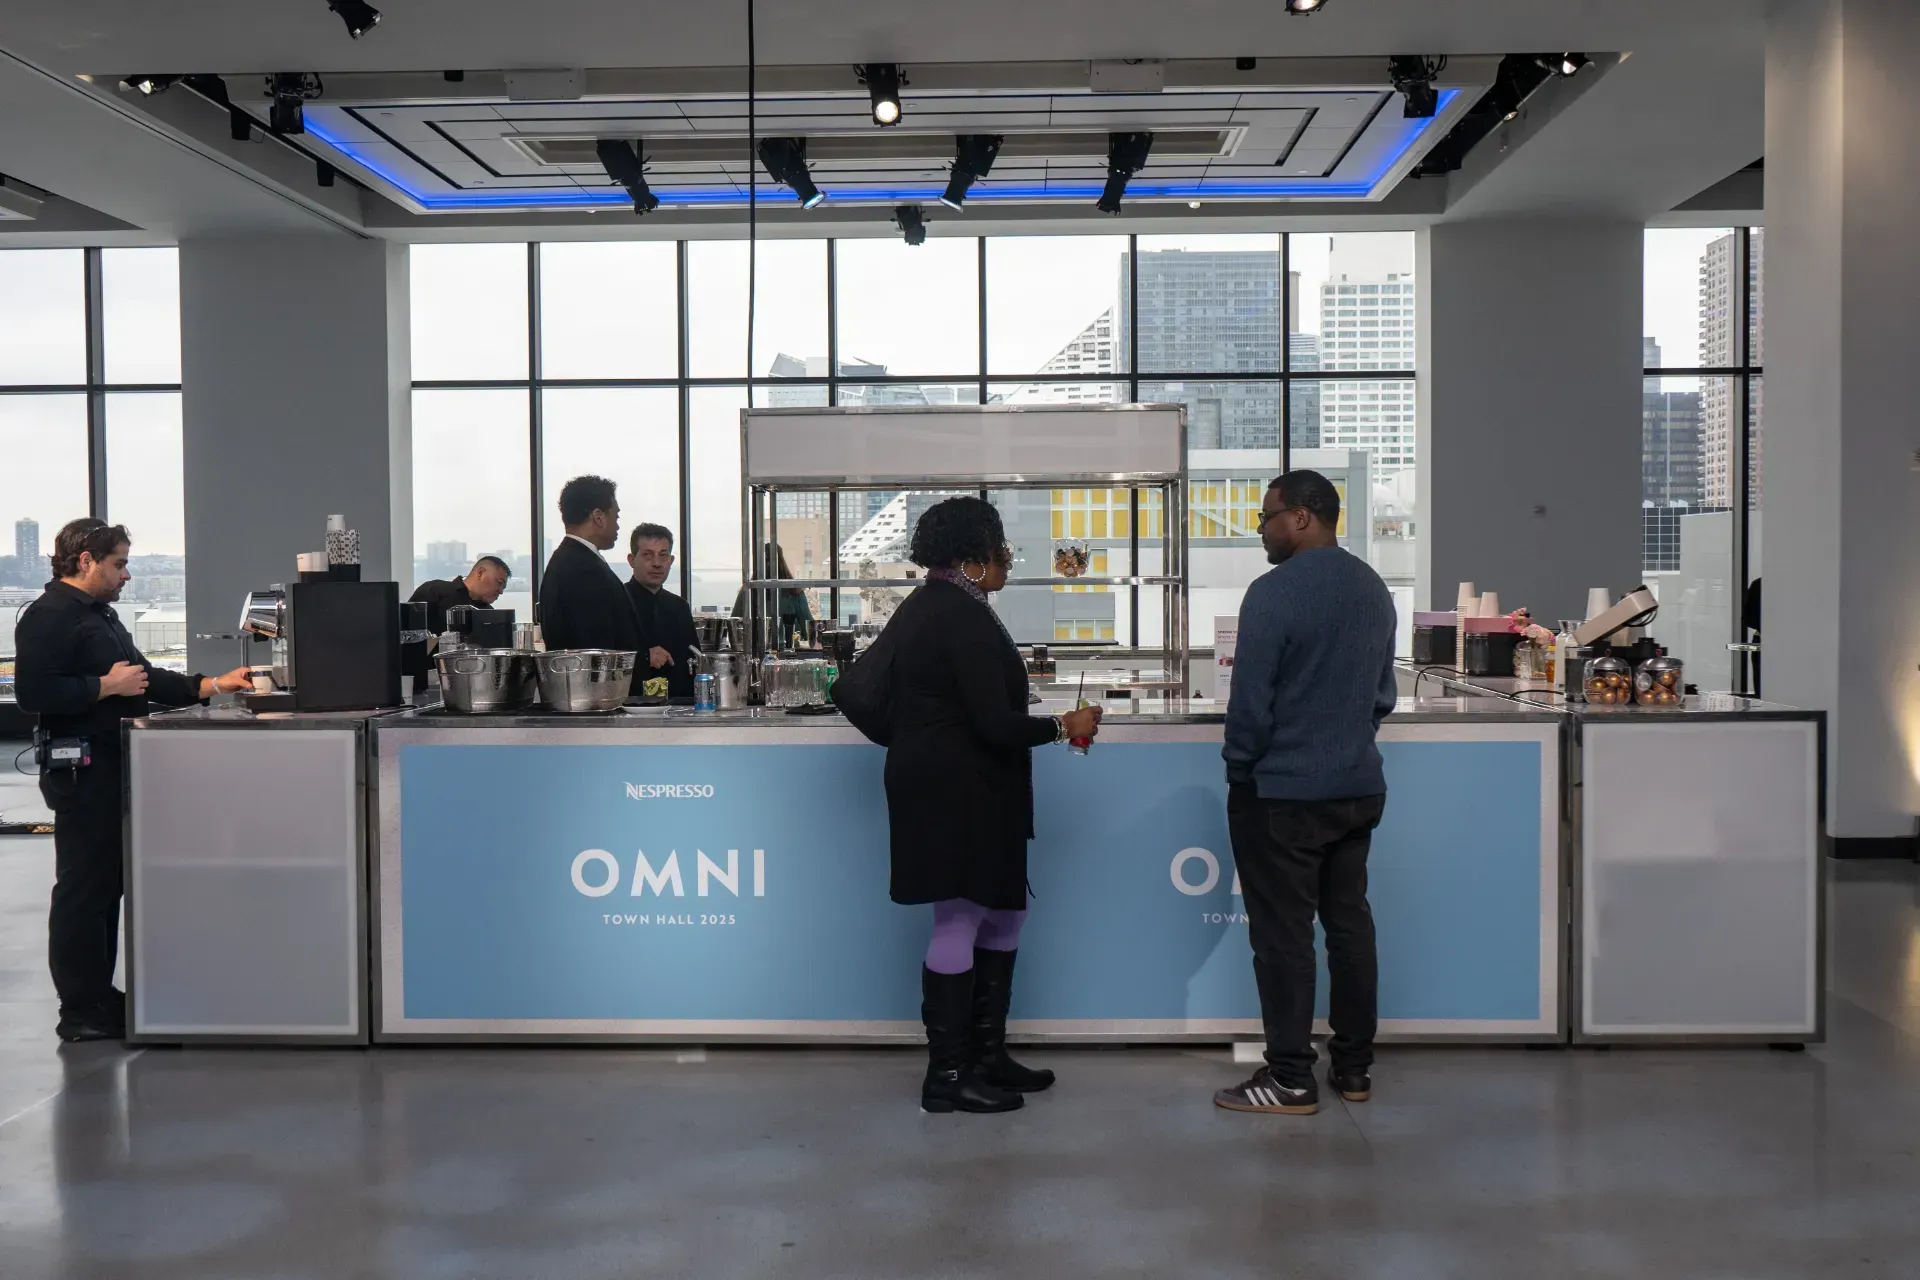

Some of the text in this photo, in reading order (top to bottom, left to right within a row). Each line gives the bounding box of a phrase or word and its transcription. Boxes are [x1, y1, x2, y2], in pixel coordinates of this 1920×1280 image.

[622, 781, 714, 800] NESPRESSO
[570, 848, 765, 897] OMNI
[602, 914, 736, 925] TOWN HALL 2025
